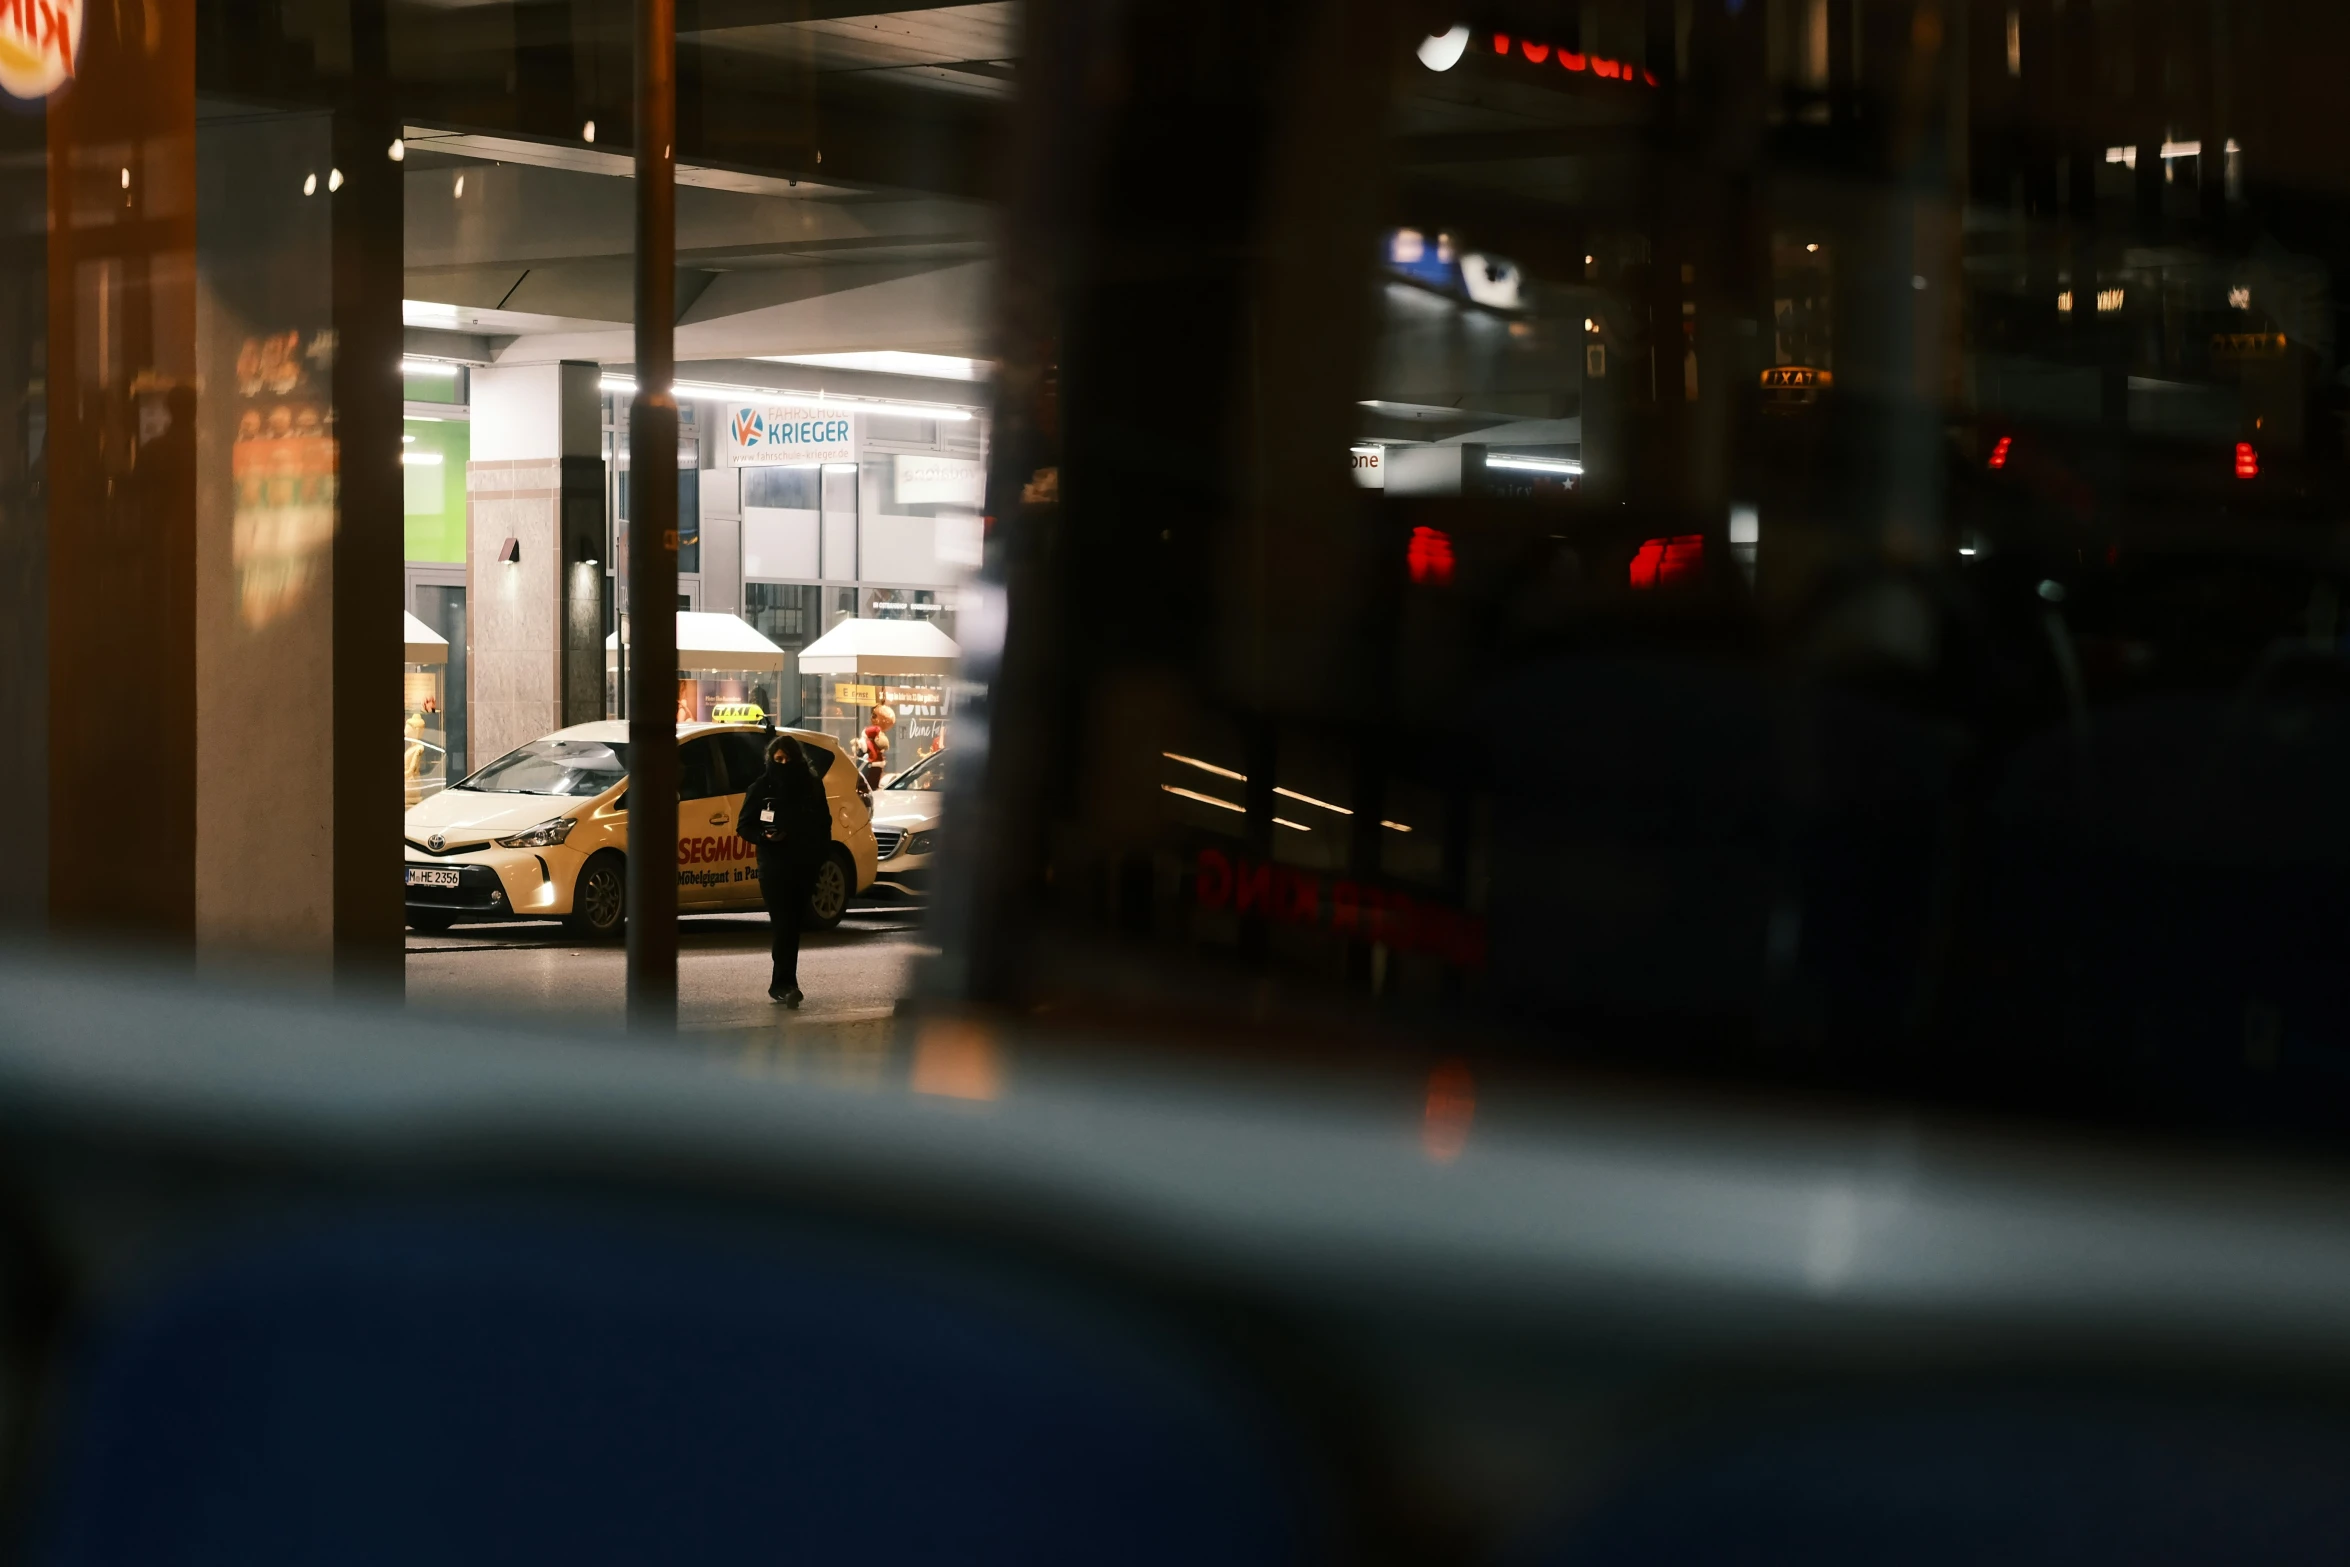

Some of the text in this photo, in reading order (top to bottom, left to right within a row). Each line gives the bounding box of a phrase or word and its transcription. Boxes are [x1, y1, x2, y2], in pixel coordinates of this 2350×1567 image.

[768, 420, 849, 444] KRIEGER
[714, 705, 751, 717] TAXI
[909, 718, 931, 739] Deine
[677, 835, 758, 865] SEGMÜL
[409, 870, 458, 884] M HE 2356
[677, 866, 759, 888] Möbelgigant in Par
